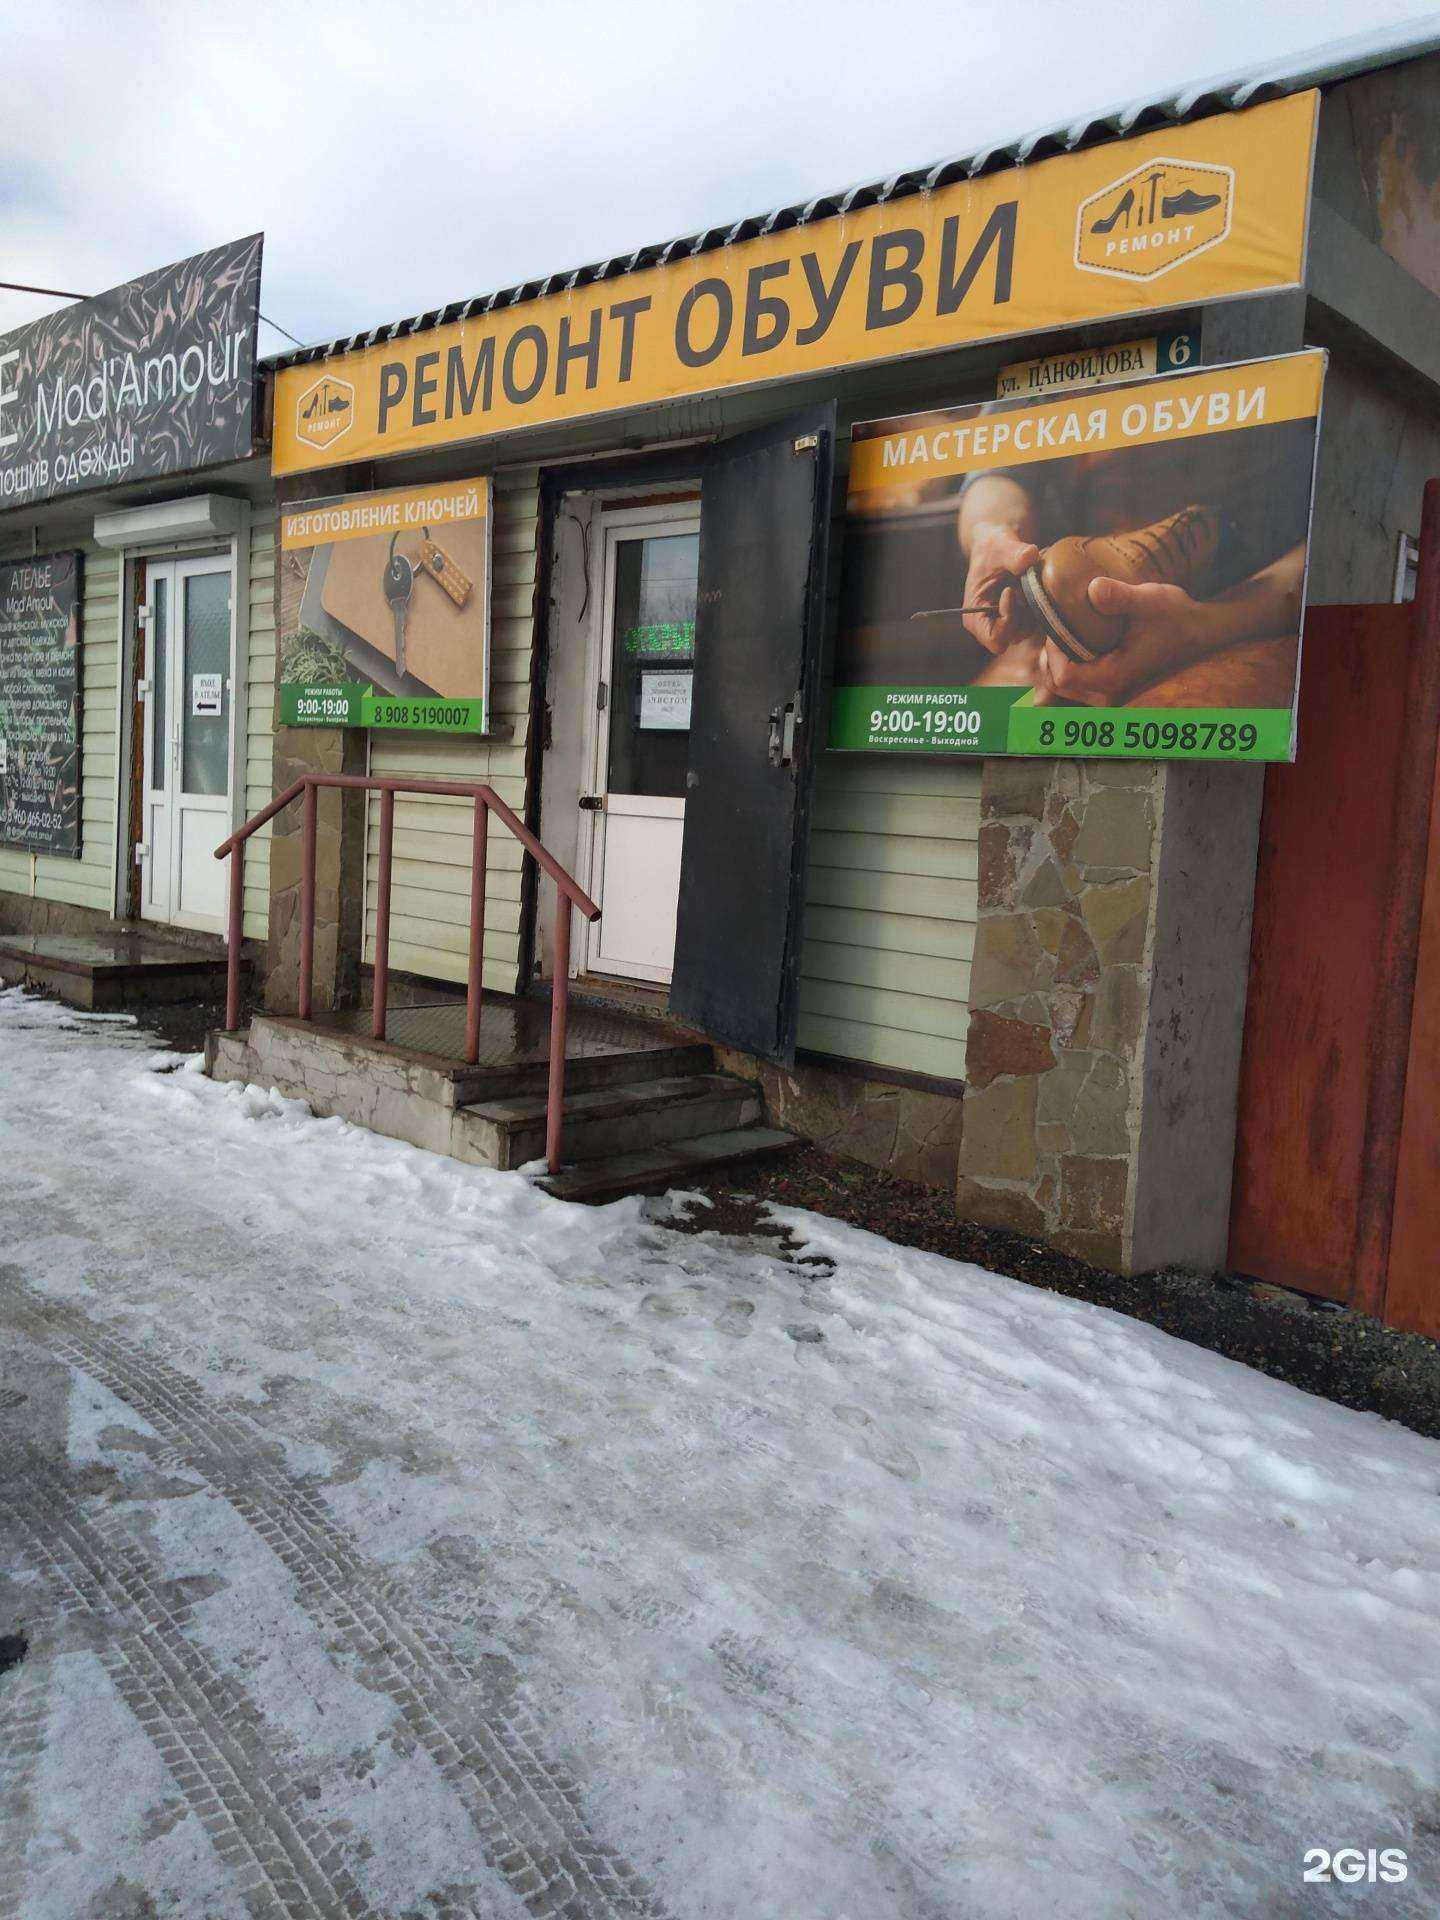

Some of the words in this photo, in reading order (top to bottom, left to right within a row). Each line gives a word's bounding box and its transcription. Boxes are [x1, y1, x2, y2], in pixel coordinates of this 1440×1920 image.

[1106, 225, 1195, 256] РЕМОНТ
[377, 296, 651, 434] РЕМОНТ
[675, 201, 1018, 367] ОБУВИ
[1001, 378, 1020, 393] ул.
[1028, 347, 1145, 388] ПАНФИЛОВА
[1168, 335, 1191, 365] 6
[36, 328, 247, 435] Mod'Amour
[307, 419, 341, 434] РЕМОНТ
[881, 407, 1108, 468] МАСТЕРСКАЯ
[1121, 385, 1267, 436] ОБУВИ
[54, 437, 135, 486] одежды
[287, 504, 400, 537] ИЗГОТОВЛЕНИЕ
[404, 488, 479, 524] КЛЮЧЕЙ
[10, 565, 52, 592] АТЕЛЬЕ
[297, 699, 349, 715] 9:00-19:00
[886, 694, 923, 705] РЕЖИМ
[925, 694, 968, 705] РАБОТЫ
[374, 706, 383, 722] 8
[386, 706, 409, 724] 908
[413, 707, 470, 726] 5190007
[870, 710, 981, 734] 9:00-19:00
[868, 735, 925, 745] Воскресенье
[931, 736, 979, 746] Выходной
[1038, 720, 1055, 746] 8
[1064, 721, 1115, 748] 908
[1123, 722, 1257, 752] 5098789
